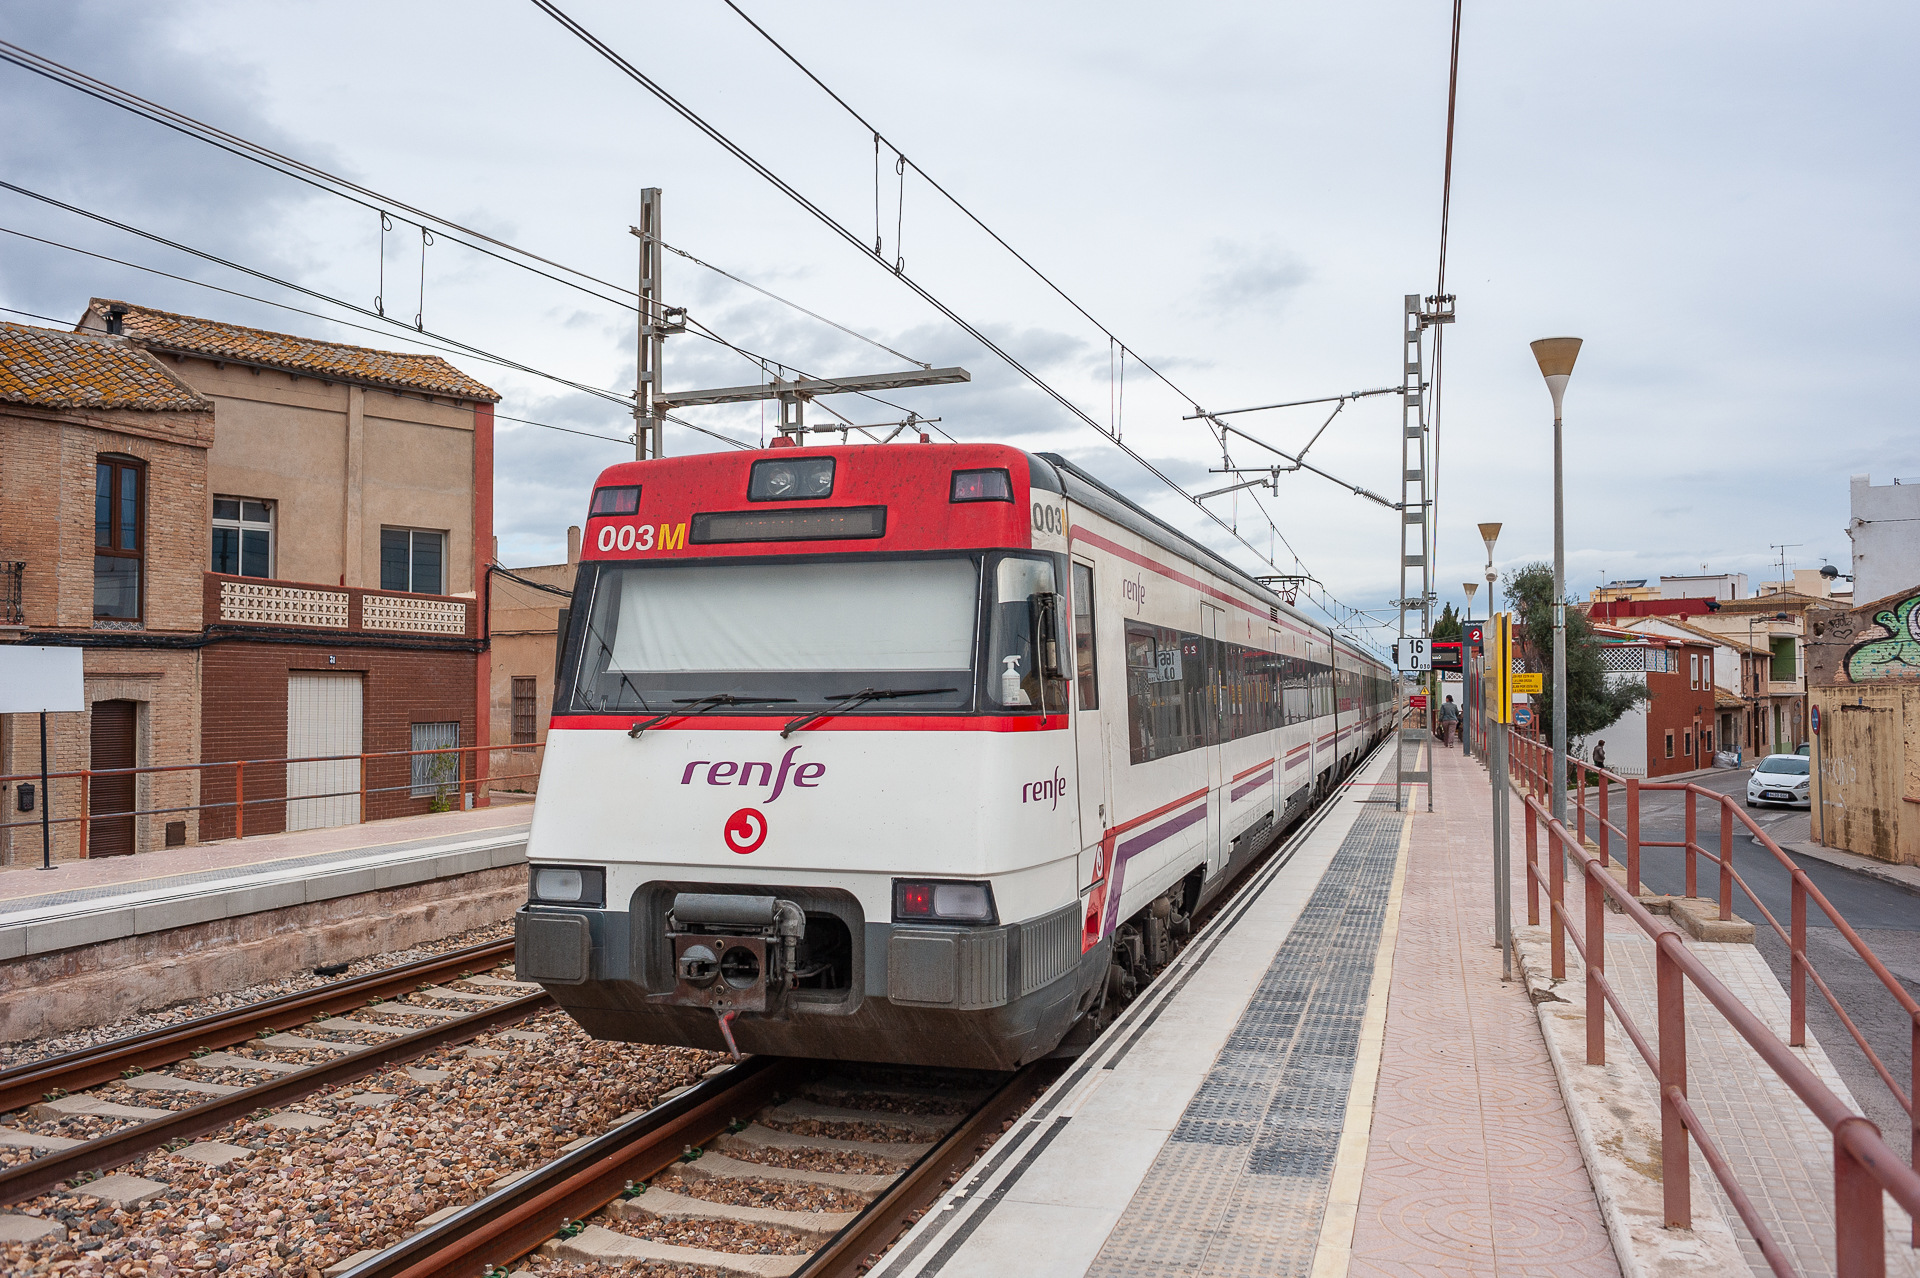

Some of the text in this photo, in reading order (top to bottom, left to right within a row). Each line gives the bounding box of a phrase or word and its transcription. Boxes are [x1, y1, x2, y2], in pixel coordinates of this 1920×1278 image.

[1122, 571, 1146, 615] renfe
[1409, 639, 1424, 654] 16
[1472, 630, 1480, 640] 2
[1411, 655, 1419, 669] 0
[681, 745, 826, 804] renfe
[1023, 765, 1066, 811] renfe
